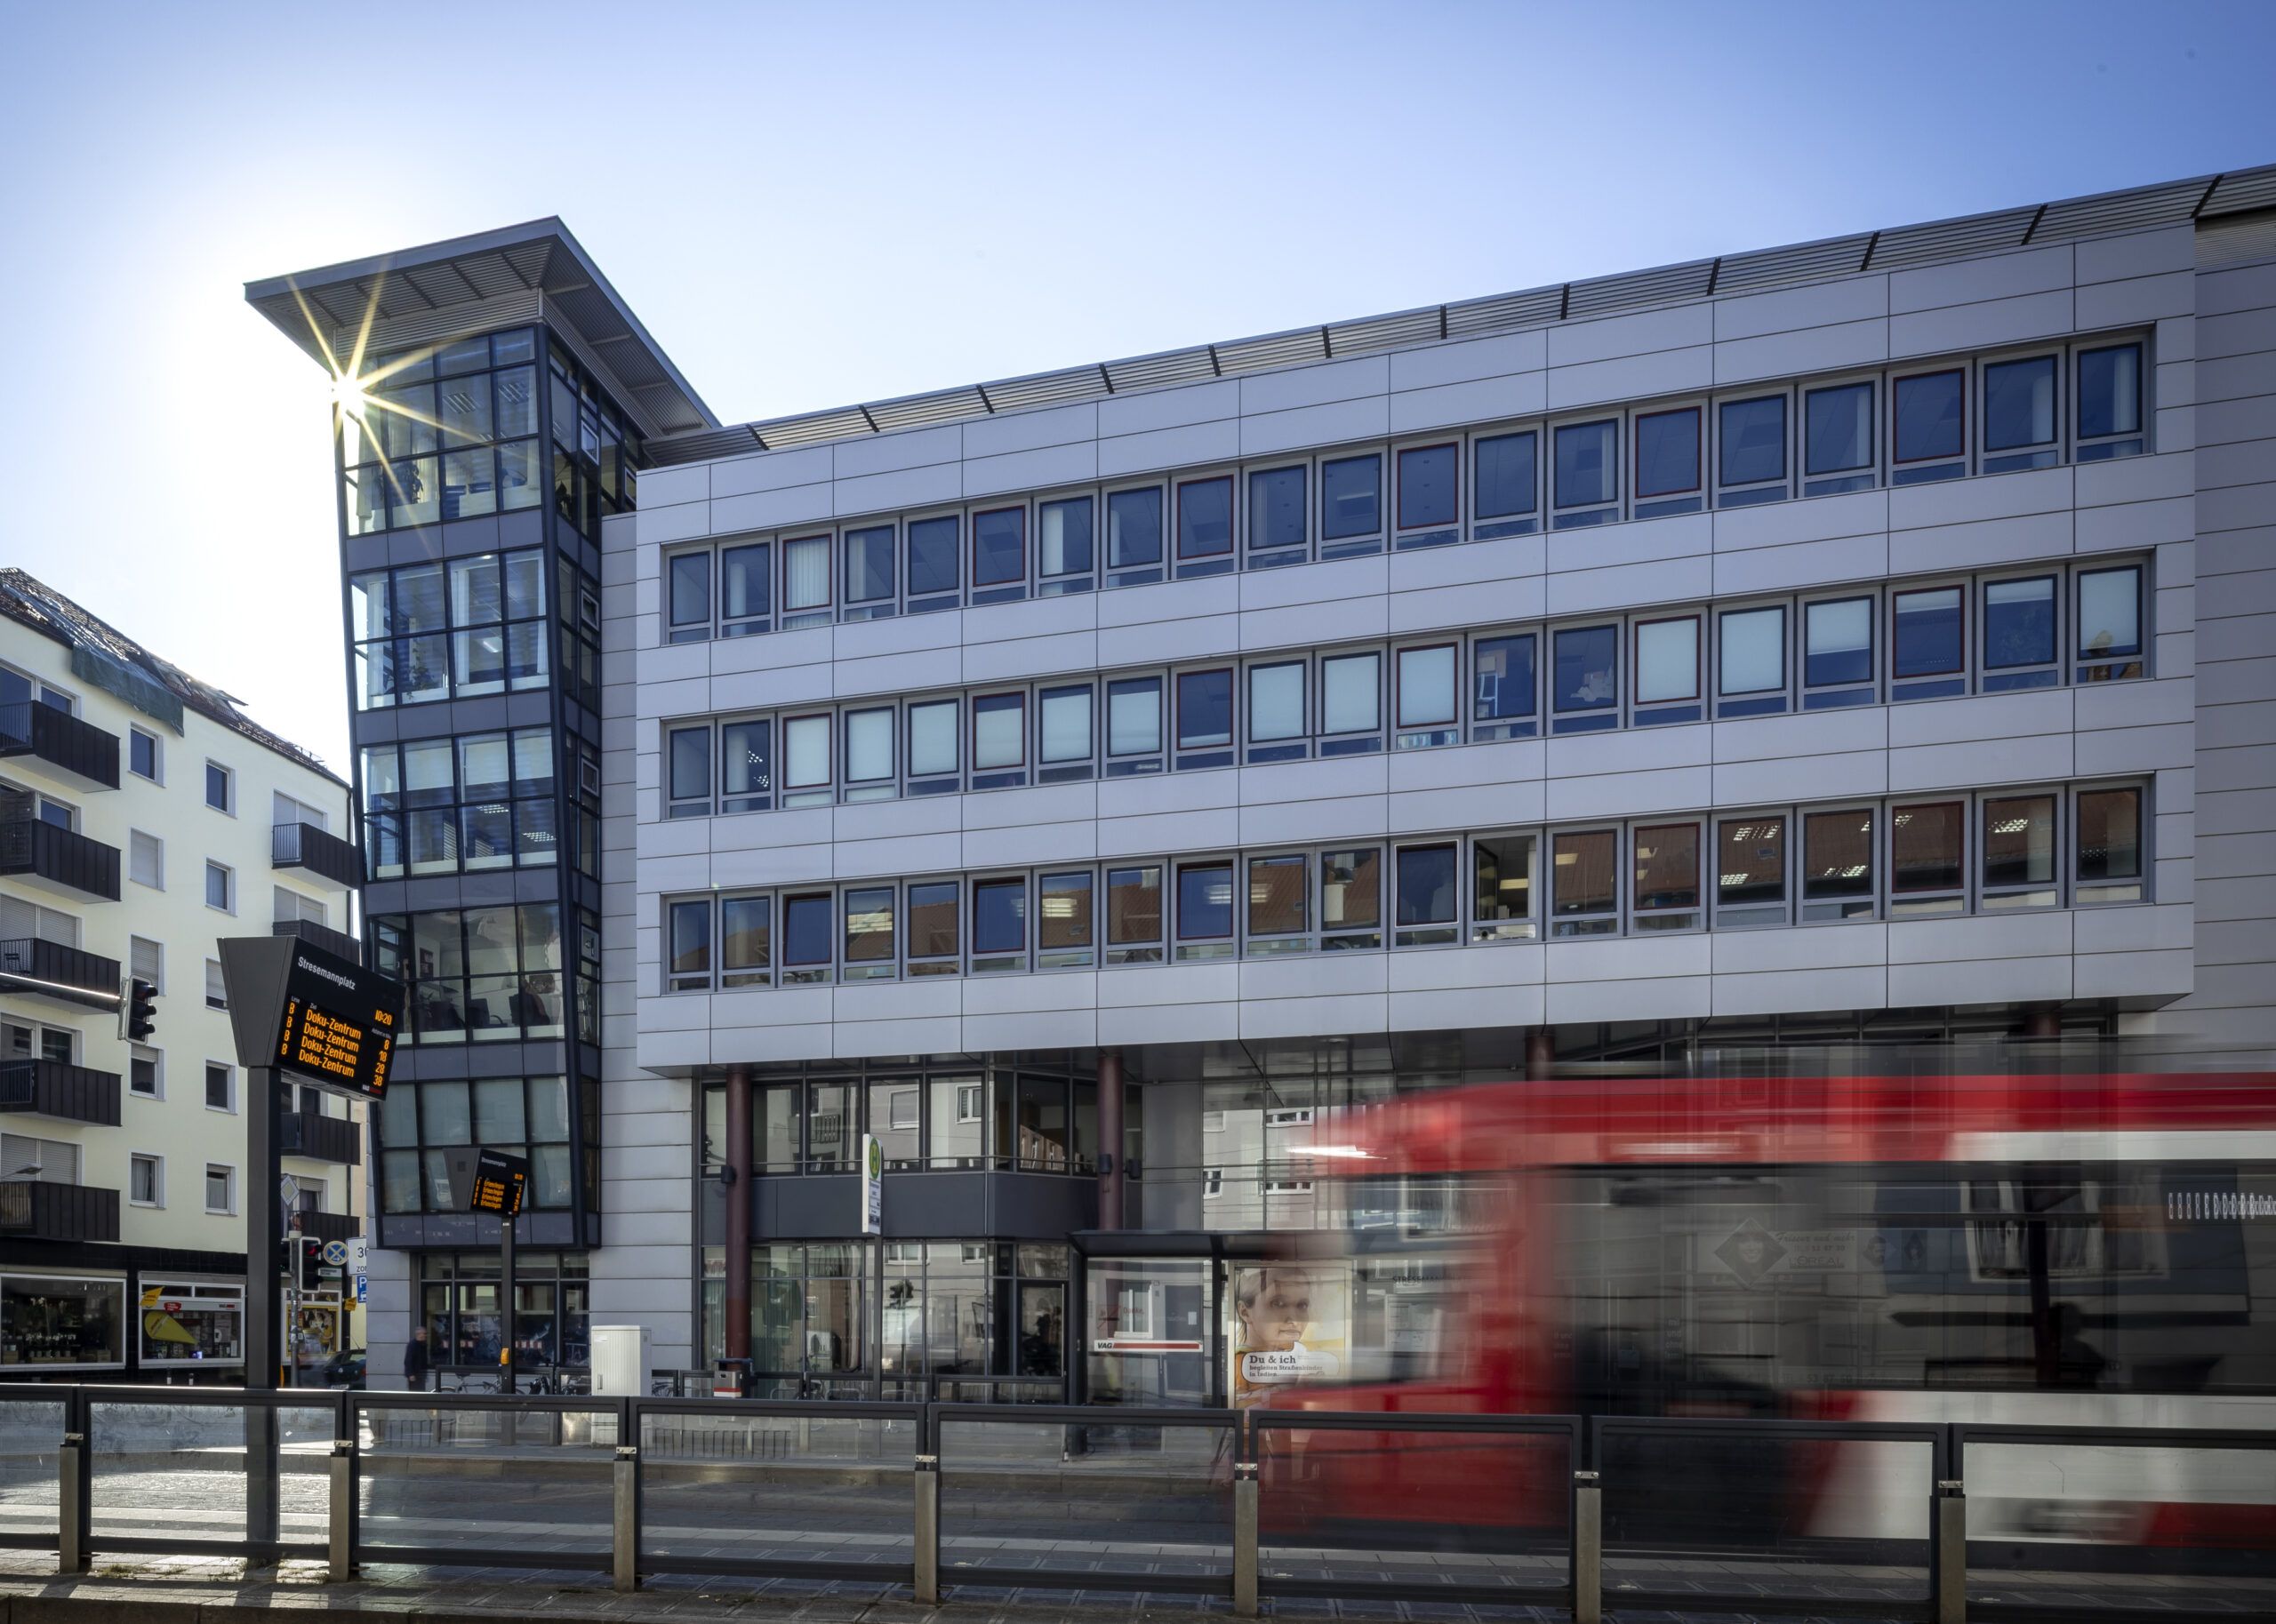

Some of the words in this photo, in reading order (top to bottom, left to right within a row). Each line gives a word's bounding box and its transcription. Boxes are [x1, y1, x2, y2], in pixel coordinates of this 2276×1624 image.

[298, 956, 356, 990] Stresemannplatz
[306, 1009, 361, 1040] Doku-Zentrum
[384, 1039, 389, 1050] 8
[374, 1010, 392, 1026] 10:20
[301, 1036, 357, 1065] Doku-Zentrum
[375, 1062, 385, 1074] 28
[303, 1023, 359, 1052] Doku-Zentrum
[379, 1051, 388, 1062] 18
[299, 1049, 355, 1077] Doku-Zentrum
[373, 1075, 383, 1086] 38
[357, 1247, 366, 1258] 3
[359, 1277, 367, 1288] P
[1249, 1355, 1264, 1364] Du
[1268, 1356, 1277, 1364] &
[1279, 1355, 1296, 1364] ich
